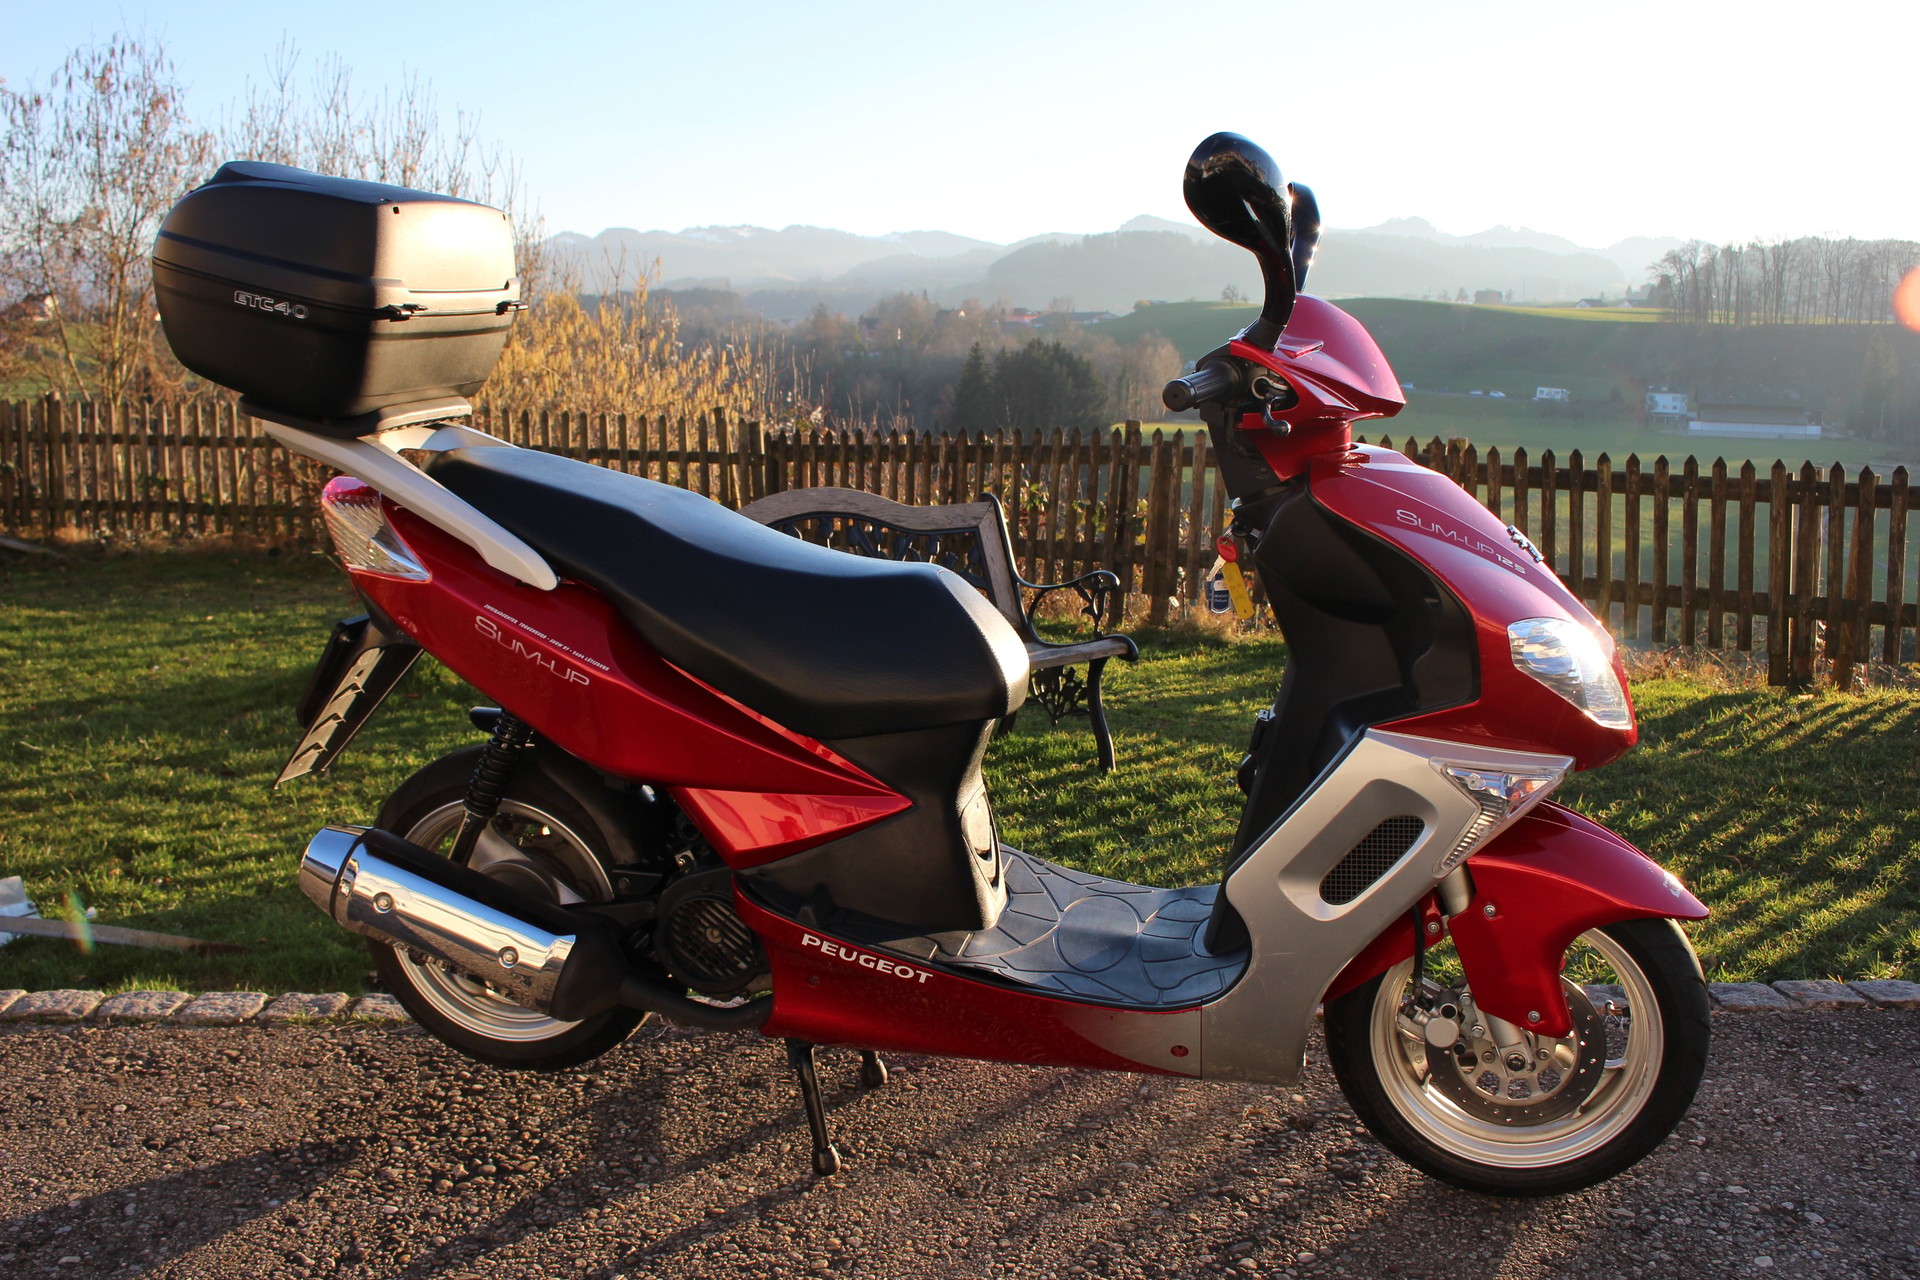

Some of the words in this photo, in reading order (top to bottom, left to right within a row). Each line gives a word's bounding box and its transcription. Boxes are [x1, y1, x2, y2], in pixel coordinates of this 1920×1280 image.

[234, 290, 309, 319] ETC40
[1396, 509, 1495, 555] SUM-UP
[1495, 553, 1526, 575] 125
[474, 615, 590, 686] SUM-UP
[801, 933, 933, 984] PEUGEOT
